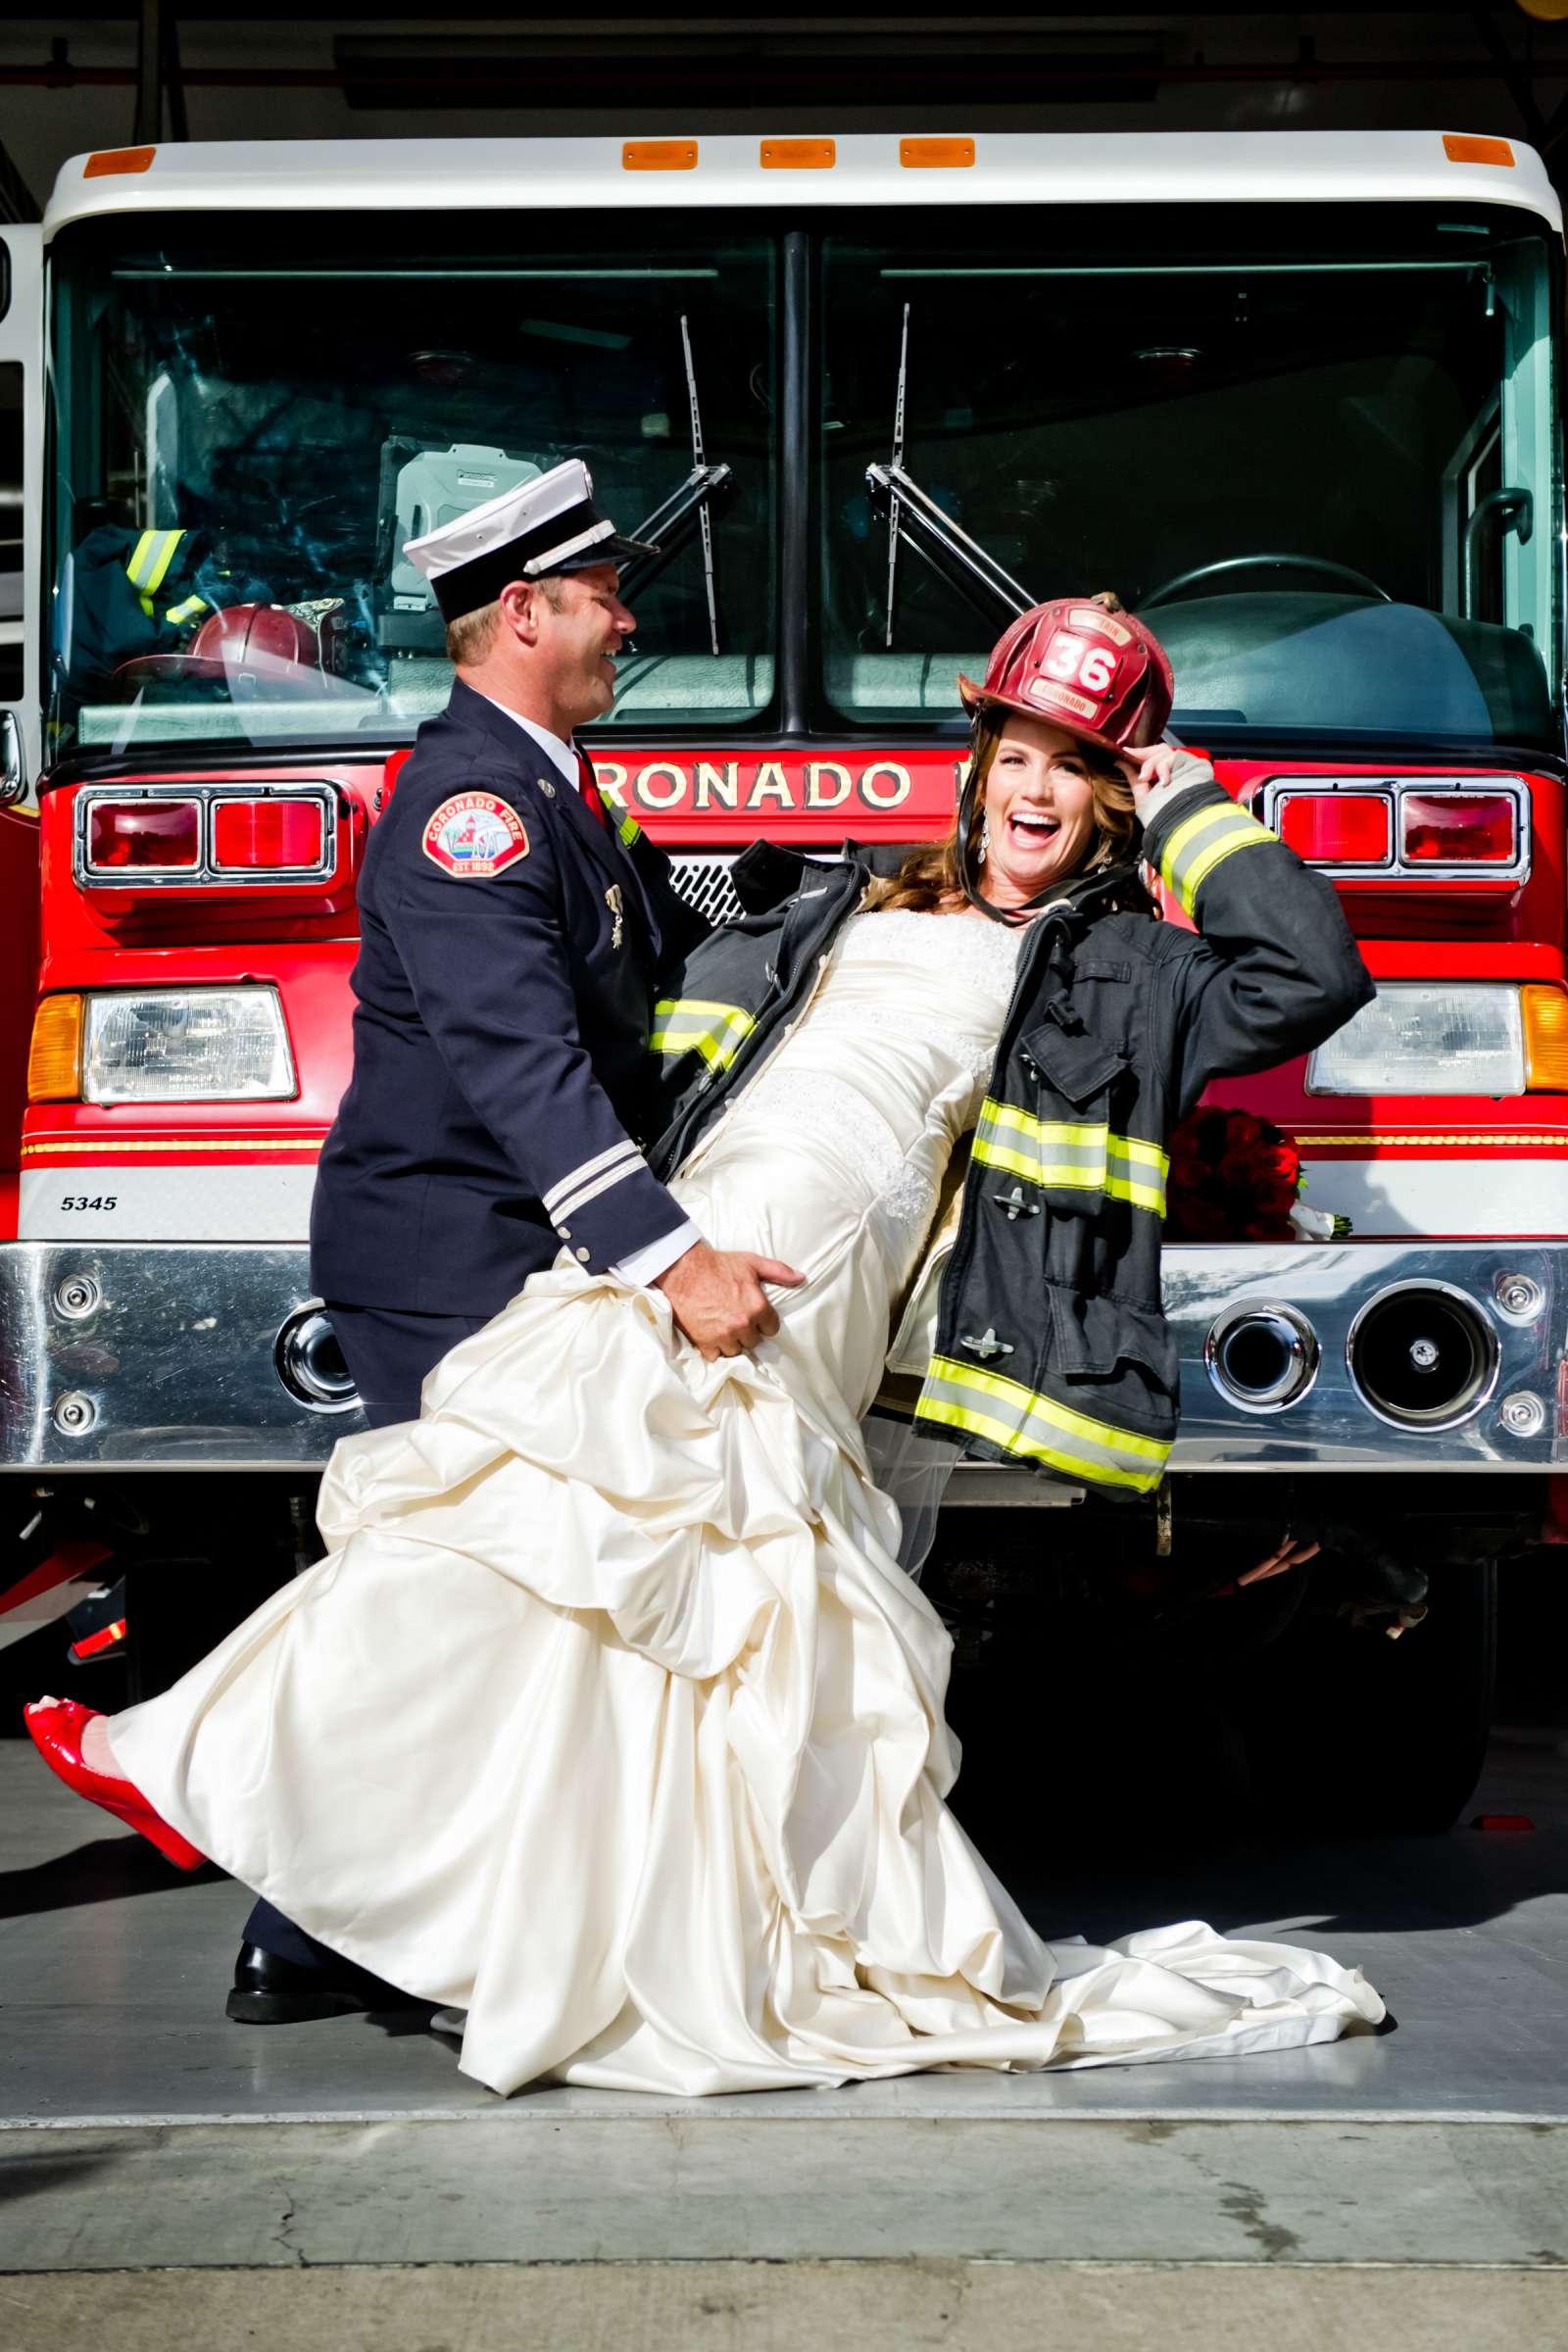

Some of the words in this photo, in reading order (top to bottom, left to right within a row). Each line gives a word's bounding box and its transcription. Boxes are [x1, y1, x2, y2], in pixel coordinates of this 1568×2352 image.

[1047, 635, 1116, 691] 36
[428, 797, 496, 842] CORONADO
[499, 808, 523, 841] FIRE
[61, 1197, 118, 1211] 5345
